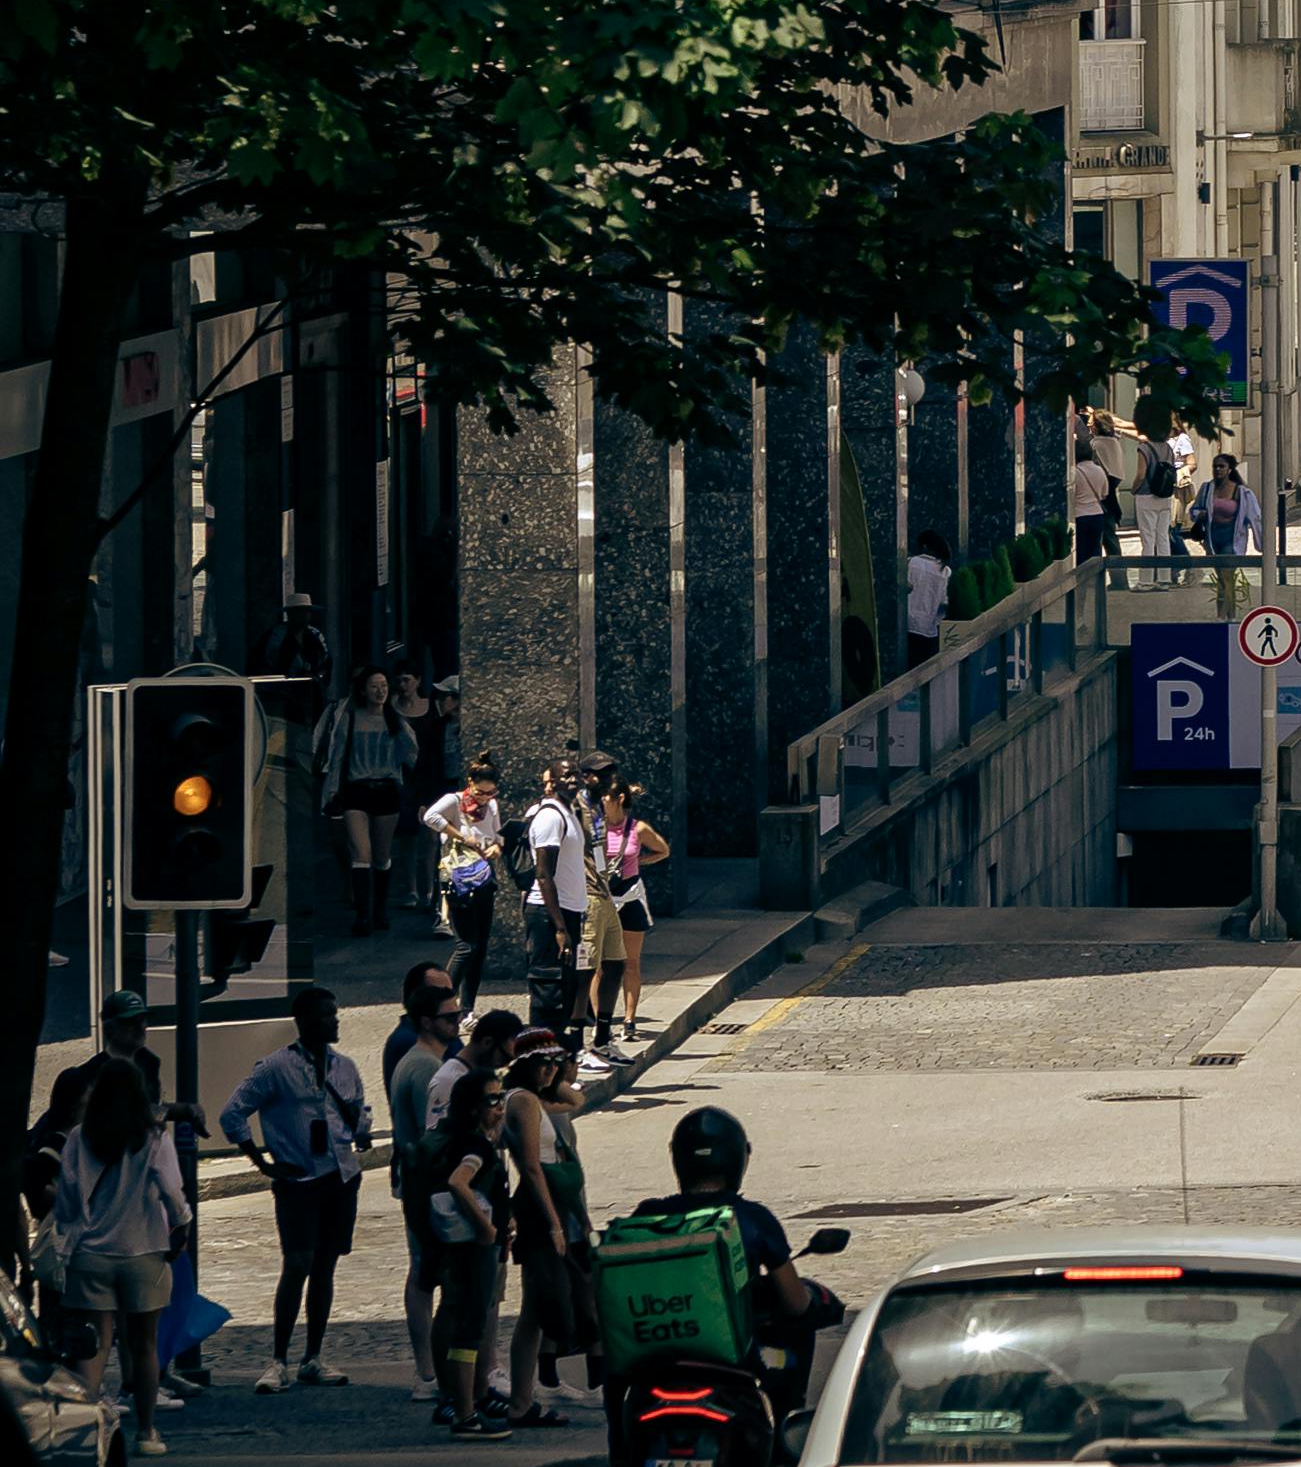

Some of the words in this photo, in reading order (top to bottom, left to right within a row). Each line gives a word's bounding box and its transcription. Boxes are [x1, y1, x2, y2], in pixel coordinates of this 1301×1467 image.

[1156, 680, 1205, 741] P
[1183, 726, 1216, 742] 24h
[627, 1293, 694, 1317] Uber
[633, 1318, 700, 1344] Eats
